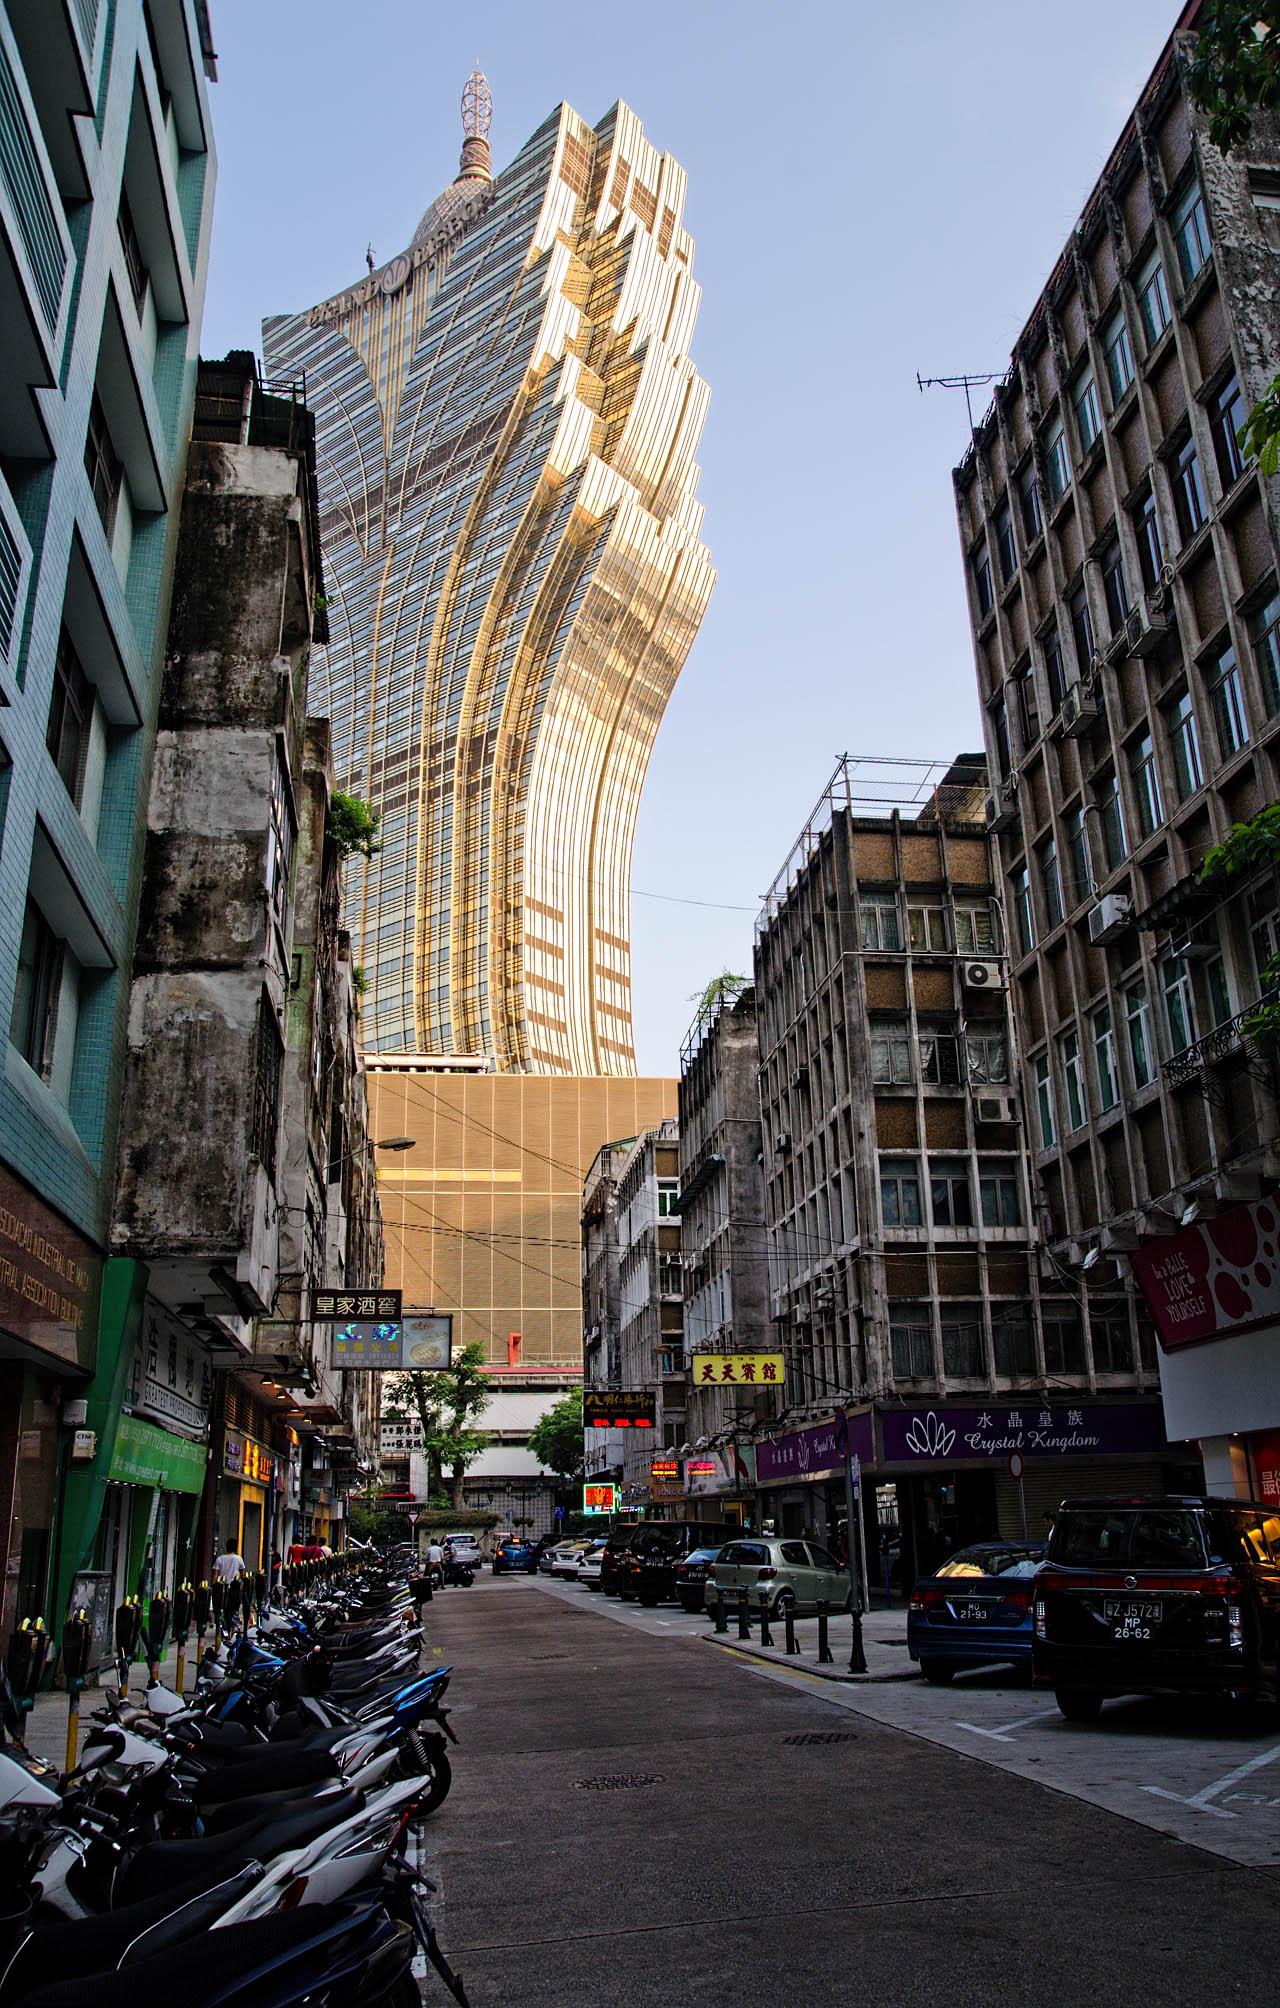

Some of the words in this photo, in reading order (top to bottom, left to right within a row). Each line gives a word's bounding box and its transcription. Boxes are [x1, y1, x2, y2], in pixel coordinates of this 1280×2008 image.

[1163, 1274, 1193, 1302] LOVE
[315, 1296, 397, 1315] 皇家酒窖
[1165, 1295, 1207, 1323] YOURSELF
[701, 1362, 777, 1382] 天天賓館
[976, 1409, 1085, 1428] 水晶皇族
[964, 1431, 1025, 1455] Crystal
[1027, 1430, 1100, 1453] Kingdom
[960, 1610, 987, 1619] 21-93
[1124, 1617, 1141, 1628] MP
[1114, 1627, 1151, 1639] 26-62
